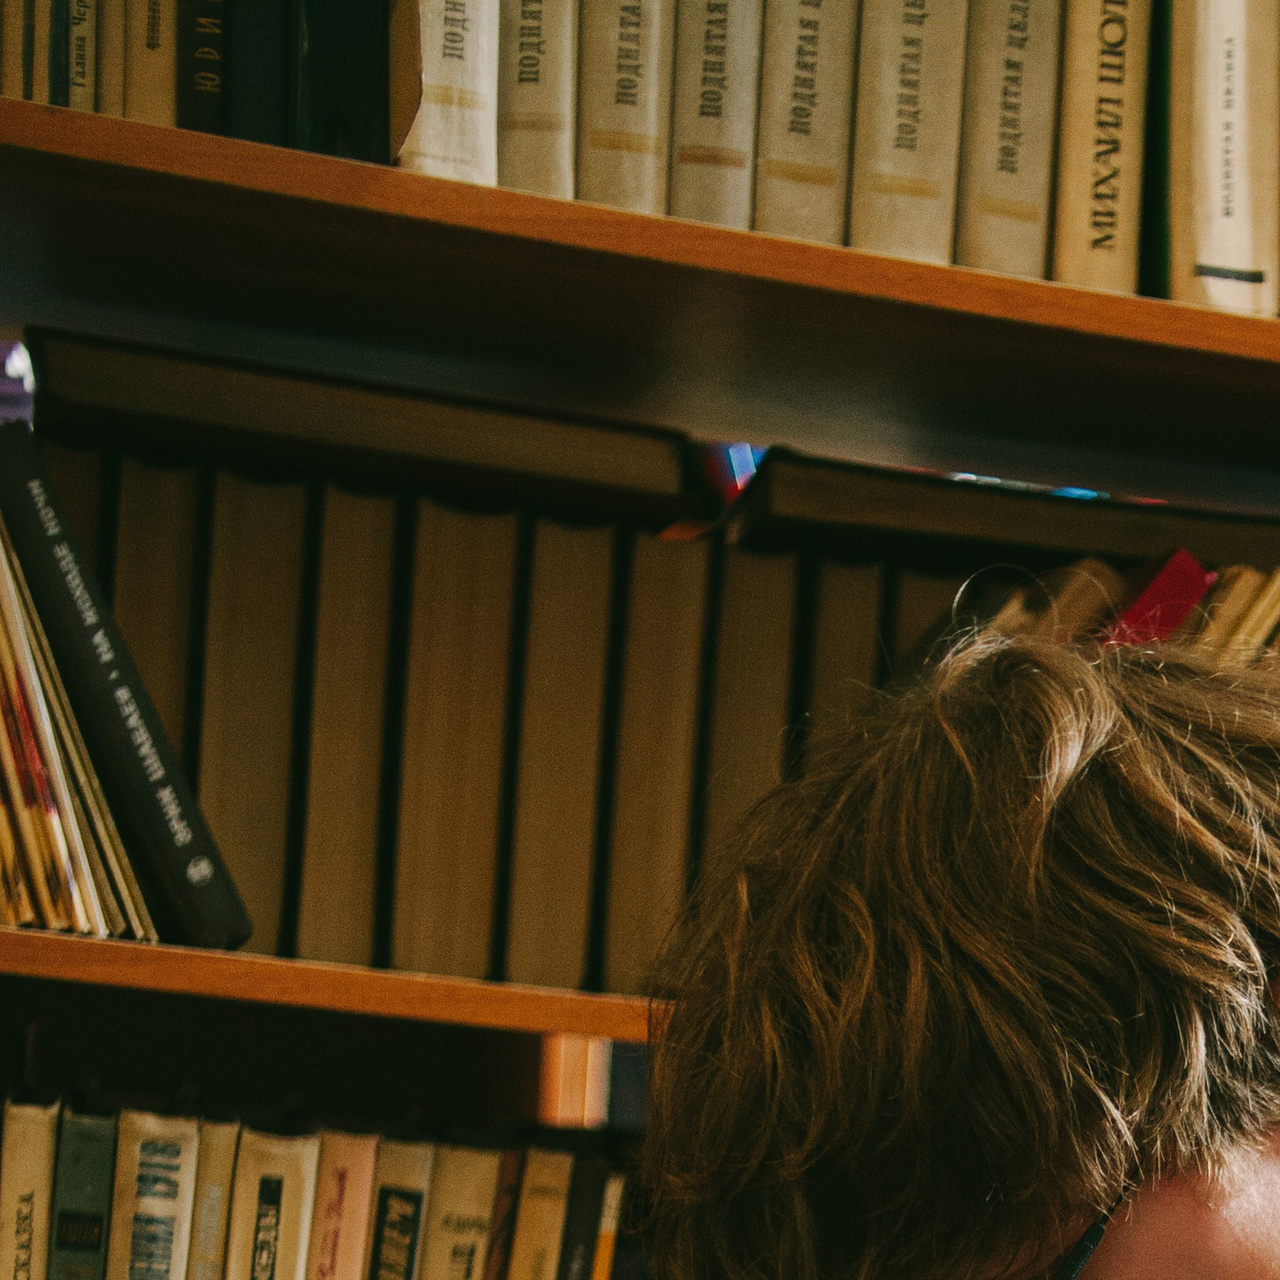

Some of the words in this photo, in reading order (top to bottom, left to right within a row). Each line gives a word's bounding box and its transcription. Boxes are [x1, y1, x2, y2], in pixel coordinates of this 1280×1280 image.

[72, 36, 88, 89] Галина
[699, 1, 728, 118] ПОДНЯТАЯ
[788, 18, 818, 136] ПОДНЯТАЯ
[893, 36, 922, 151] ПОДНЯТАЯ
[997, 59, 1024, 174] ПОДНЯТАЯ
[1090, 97, 1124, 252] МИХАИЛ
[1222, 121, 1237, 218] ПОДНЯТАЯ
